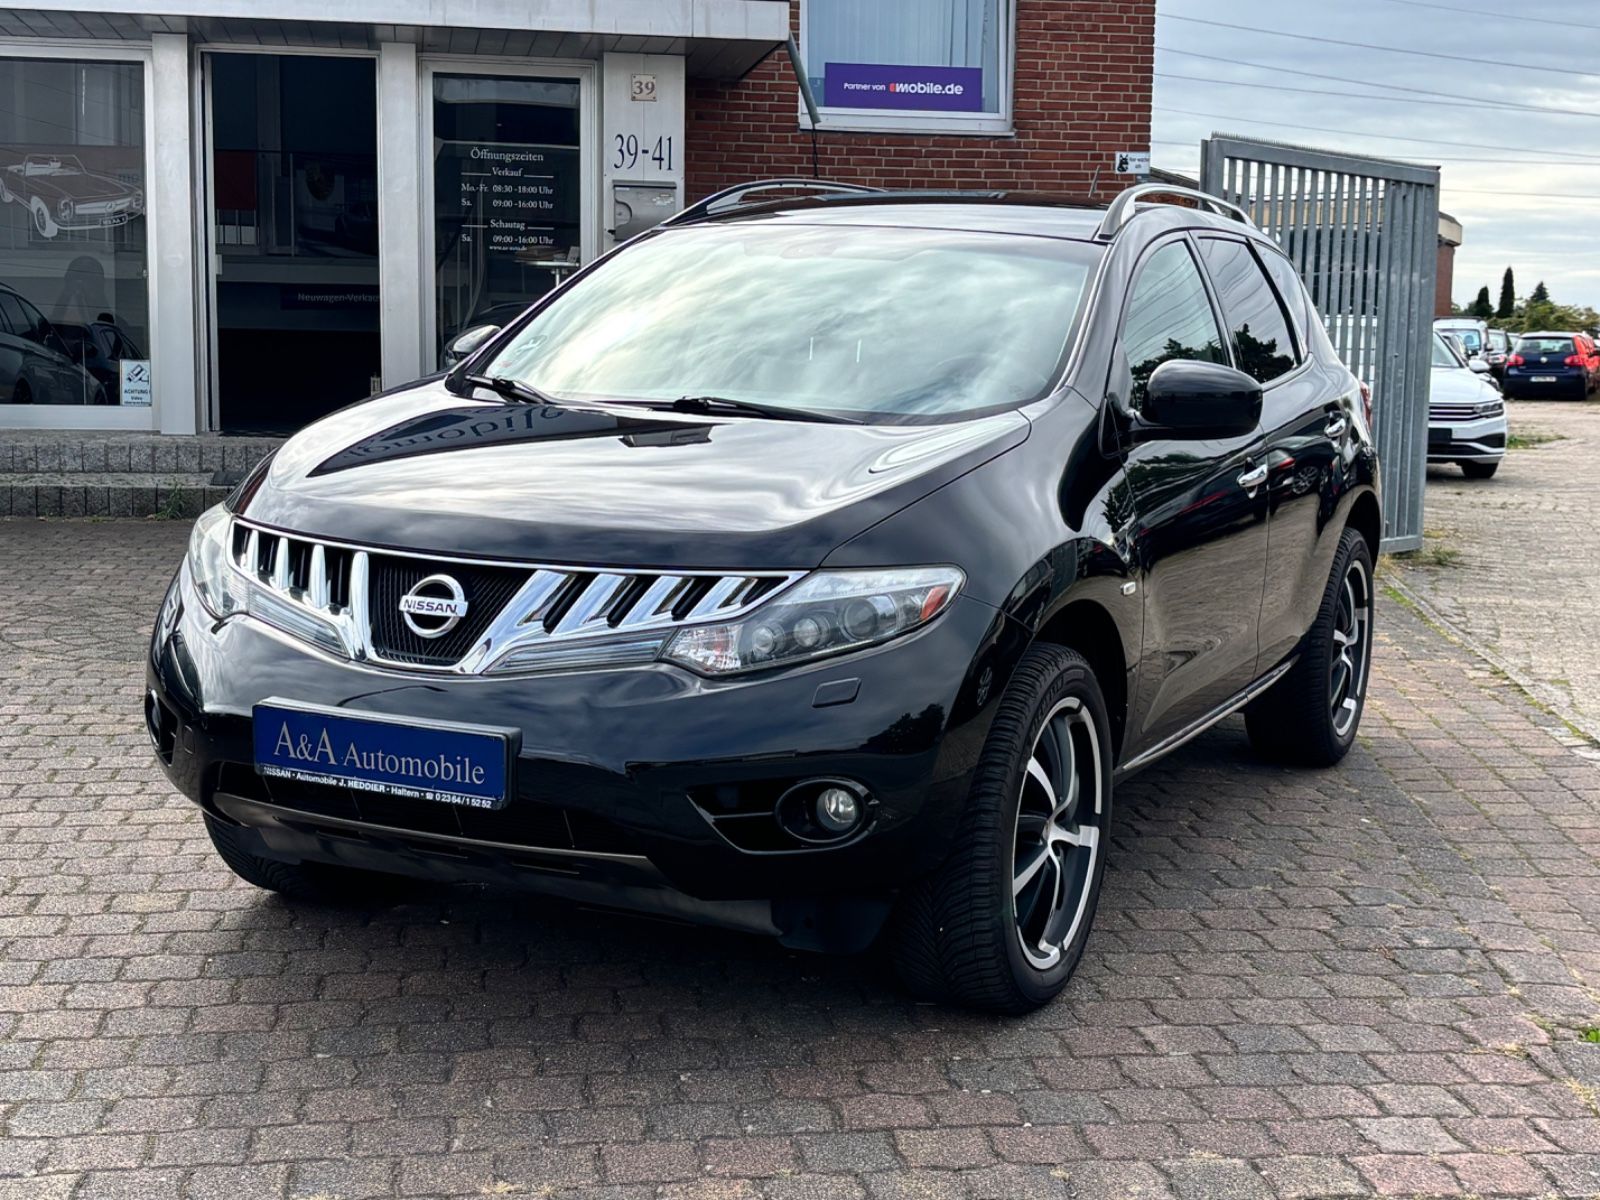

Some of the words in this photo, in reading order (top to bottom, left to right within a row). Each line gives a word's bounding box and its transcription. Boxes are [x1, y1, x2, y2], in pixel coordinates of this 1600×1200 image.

[633, 81, 656, 95] 39
[843, 82, 871, 91] Partner
[872, 83, 886, 91] von
[889, 82, 964, 95] mobile.de
[470, 147, 544, 163] Öffnungszeiten
[613, 133, 673, 171] 39-41
[492, 167, 523, 177] Verkauf
[539, 186, 553, 195] Uhr
[492, 199, 513, 207] 09:00
[539, 200, 553, 209] Uhr
[490, 219, 525, 231] Schautag
[492, 235, 513, 243] 09:00
[539, 236, 554, 245] Uhr
[403, 599, 457, 614] NISSAN
[273, 721, 338, 766] A&A
[343, 742, 485, 785] Automobile
[263, 766, 292, 778] NISSAN
[296, 772, 337, 786] Automobile
[338, 778, 346, 787] J.
[347, 779, 386, 793] HEDDIER
[391, 786, 419, 798] Haltern
